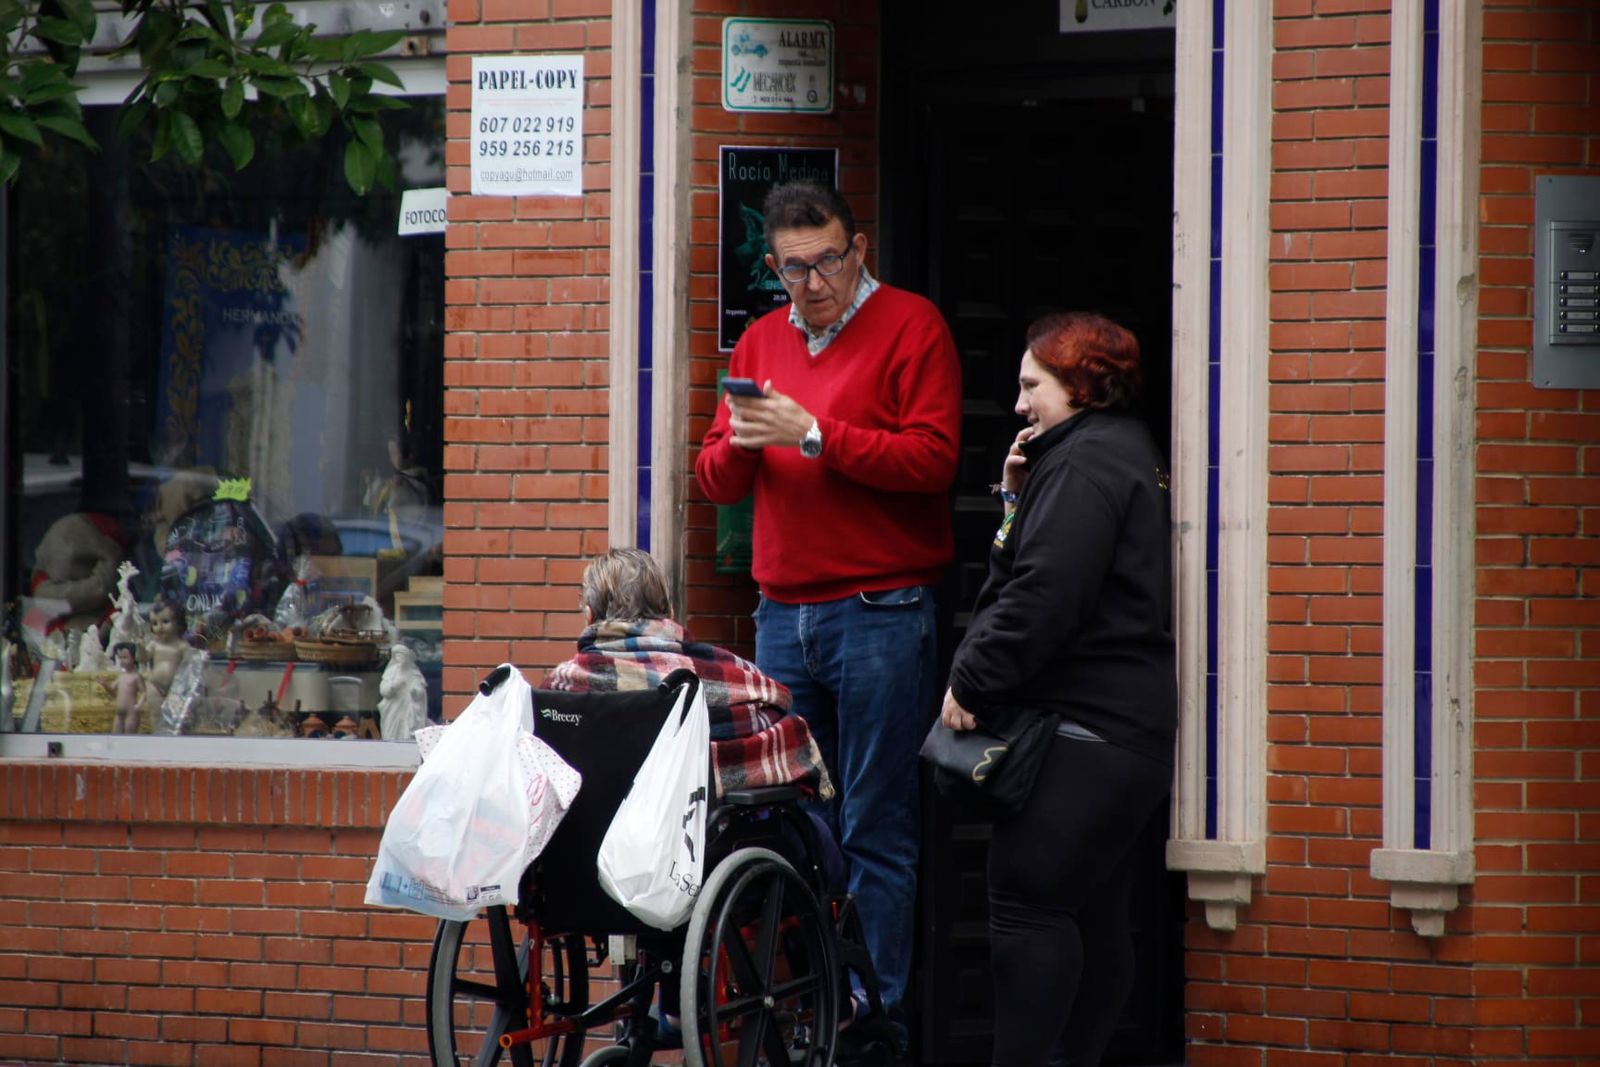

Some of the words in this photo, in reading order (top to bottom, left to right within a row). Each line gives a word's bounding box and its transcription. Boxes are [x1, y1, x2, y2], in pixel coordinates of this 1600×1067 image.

[778, 31, 826, 49] ALARMA
[478, 69, 577, 90] PAPEL-COPY
[479, 117, 508, 133] 607
[513, 117, 542, 133] 022
[546, 117, 574, 133] 919
[479, 141, 508, 156] 959
[513, 141, 541, 156] 256
[546, 140, 574, 156] 215
[552, 709, 581, 726] Breezy
